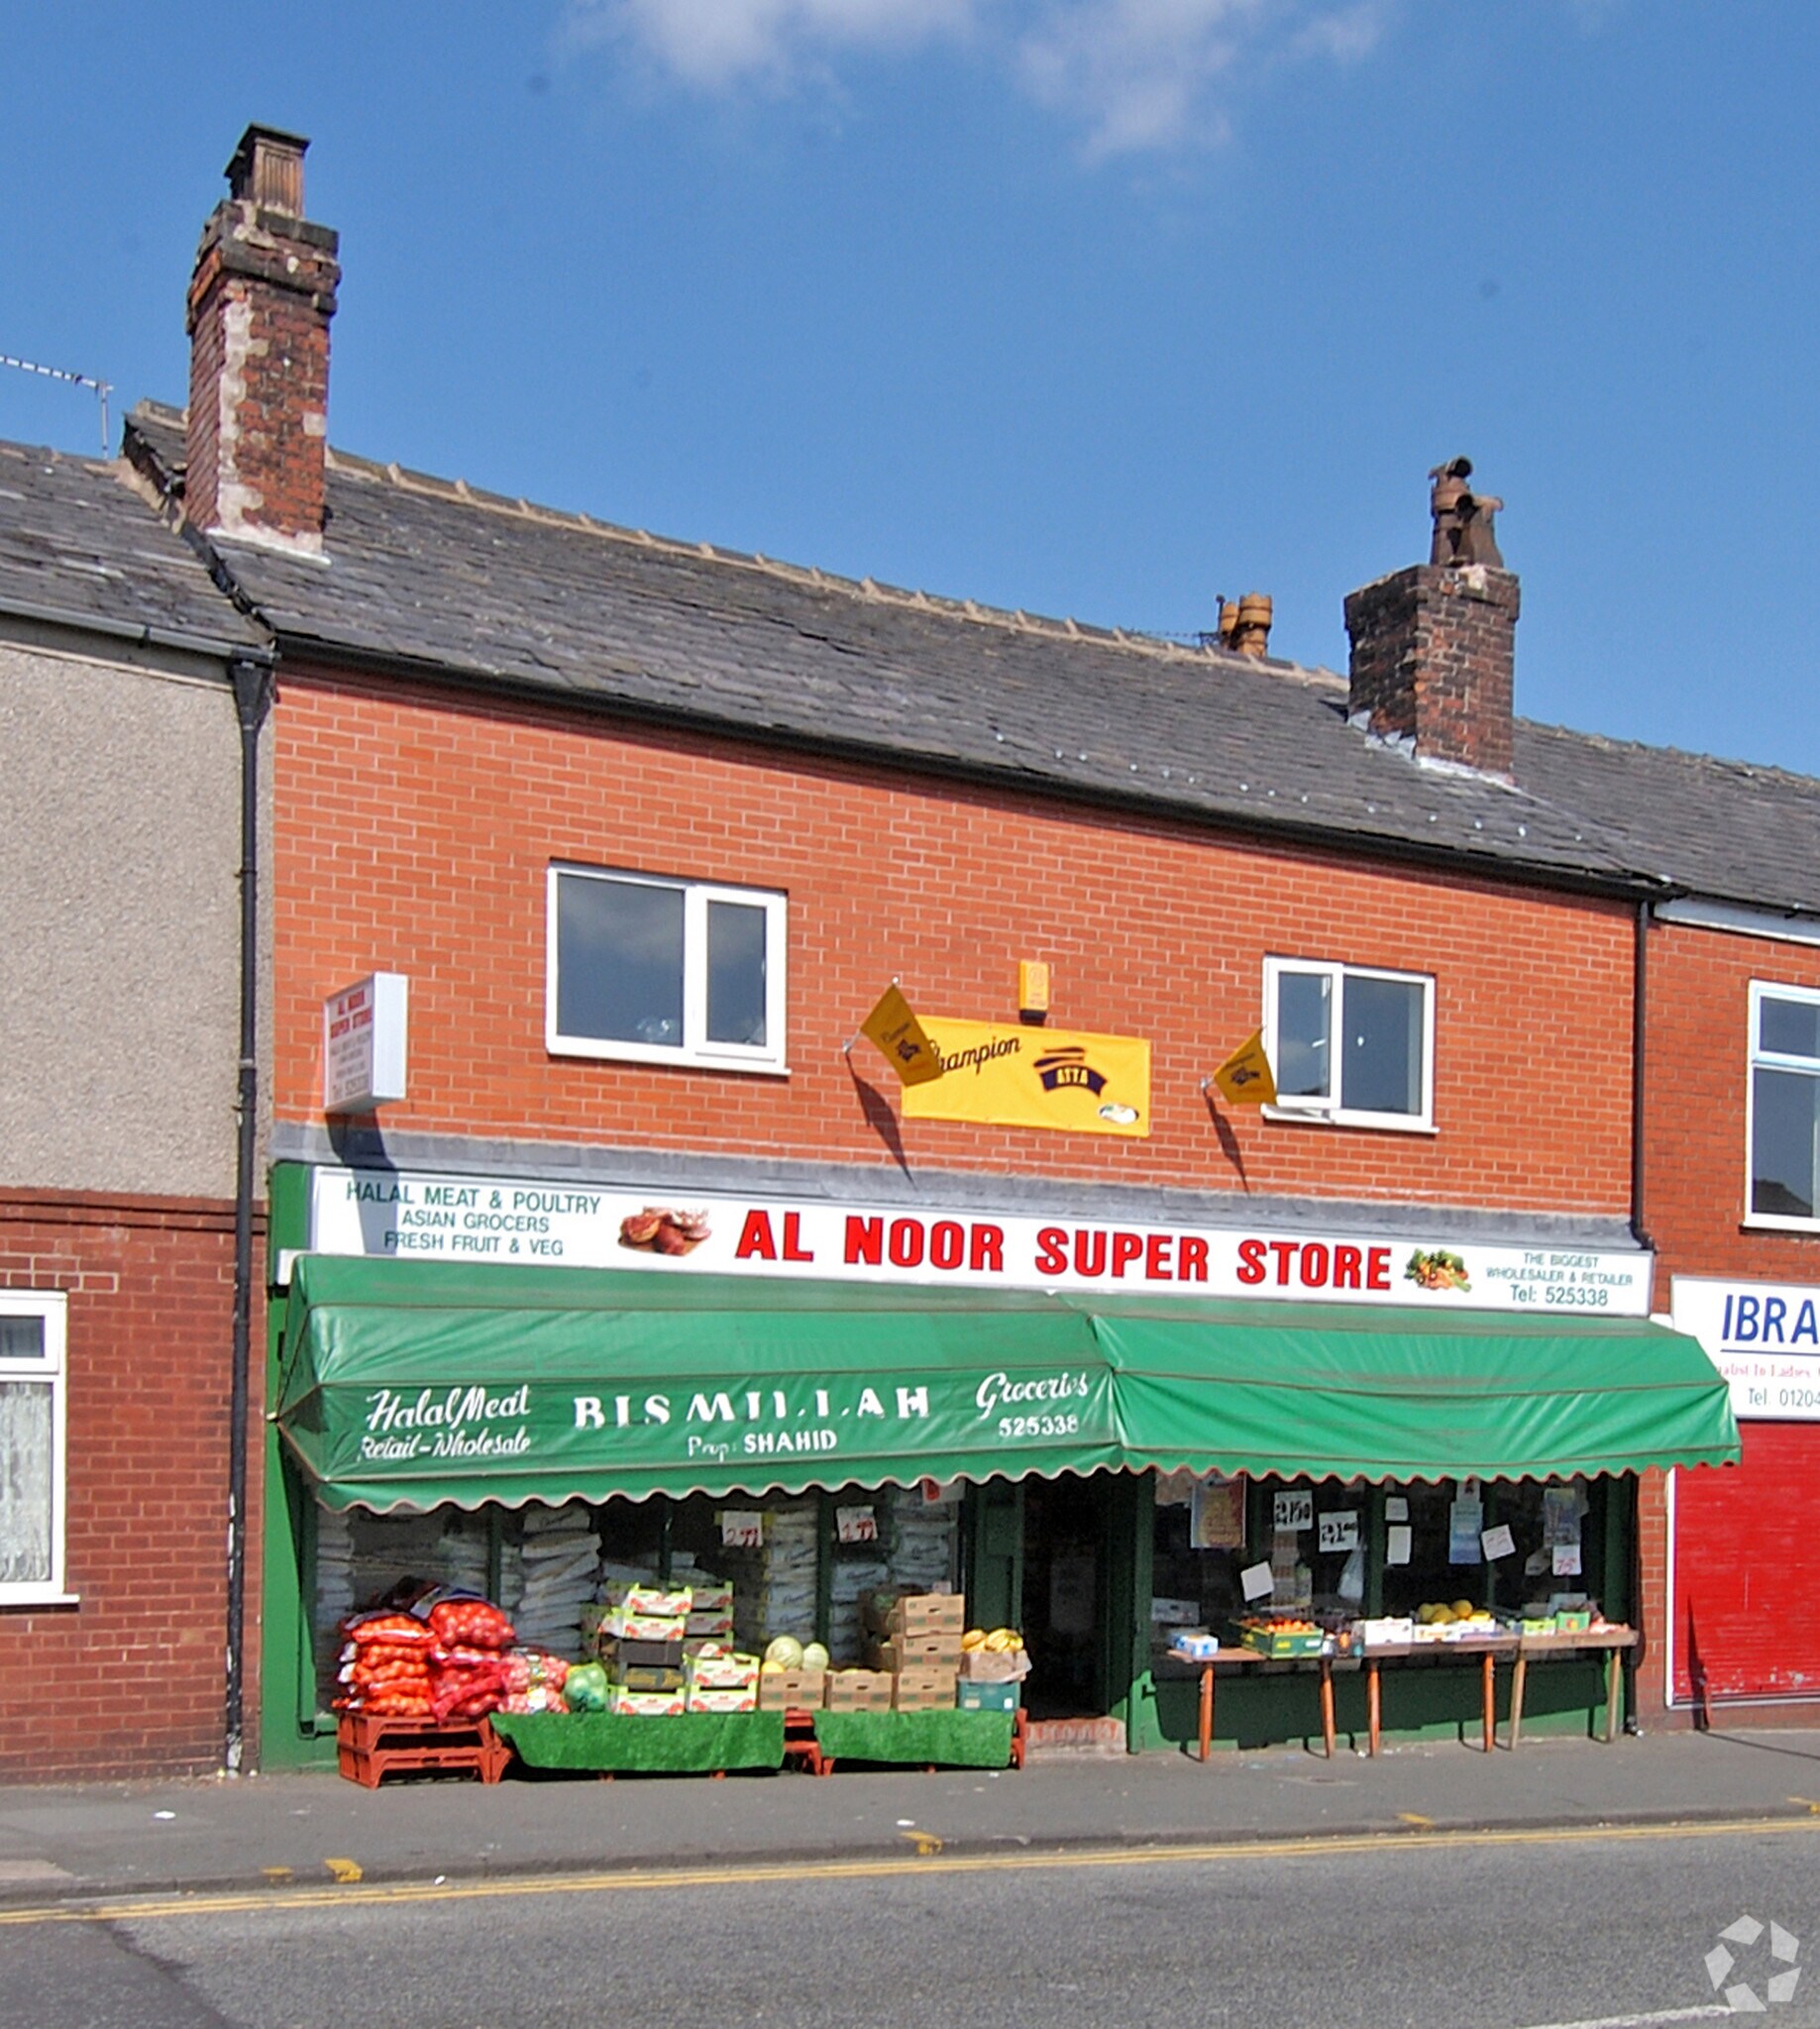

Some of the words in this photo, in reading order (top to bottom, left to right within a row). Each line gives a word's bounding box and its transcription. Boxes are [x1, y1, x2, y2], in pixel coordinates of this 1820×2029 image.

[1056, 1068, 1088, 1085] ATTA
[346, 1182, 414, 1204] HALAL
[424, 1187, 479, 1208] MEAT
[489, 1192, 502, 1210] &
[513, 1192, 601, 1215] POULTRY
[402, 1211, 456, 1230] ASIAN
[464, 1214, 549, 1233] GROCERS
[384, 1231, 444, 1251] FRESH
[452, 1234, 501, 1252] FRUIT
[509, 1237, 521, 1254] &
[529, 1238, 564, 1256] VEG
[735, 1210, 814, 1261] AL
[843, 1216, 1005, 1271] NOOR
[1033, 1227, 1209, 1282] SUPER
[1235, 1238, 1392, 1291] STORE
[1524, 1252, 1545, 1265] THE
[1550, 1253, 1599, 1268] BIGGEST
[1486, 1267, 1565, 1283] WHOLESALER
[1569, 1270, 1576, 1283] &
[1581, 1271, 1633, 1286] RETAILER
[1510, 1284, 1537, 1303] Tel:
[1546, 1286, 1608, 1307] 525338
[1722, 1294, 1819, 1344] IBRA
[366, 1387, 462, 1432] Halal
[449, 1384, 532, 1430] Meat
[999, 1414, 1079, 1439] 525338
[744, 1430, 839, 1454] SHAHID
